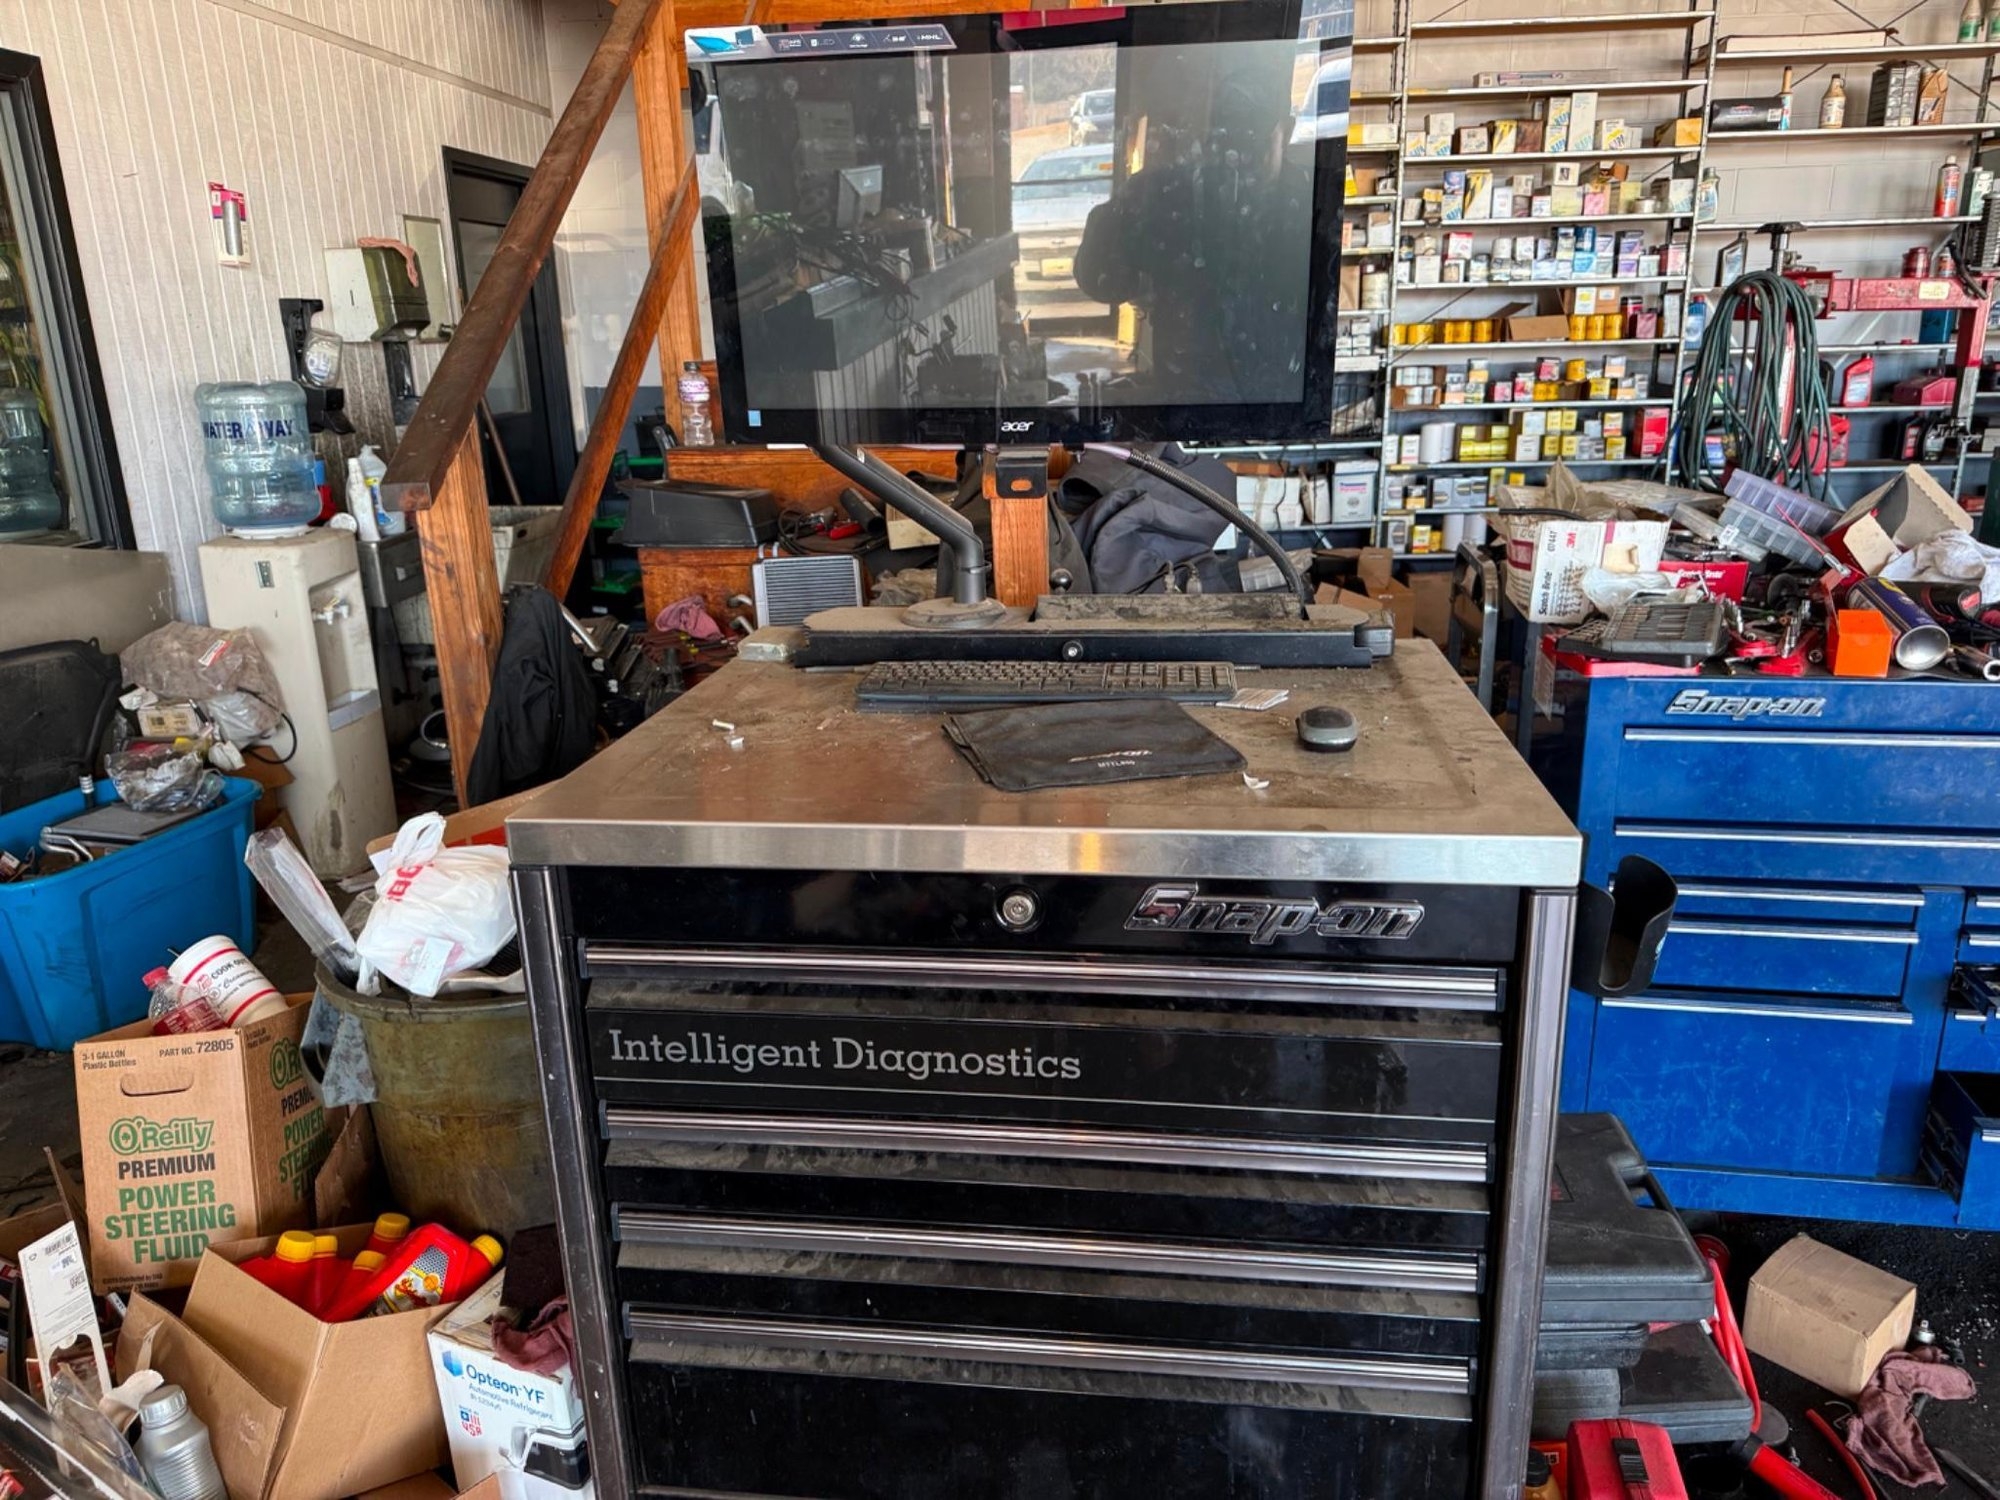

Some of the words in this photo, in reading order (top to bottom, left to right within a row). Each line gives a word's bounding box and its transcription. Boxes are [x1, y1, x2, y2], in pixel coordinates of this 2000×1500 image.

[1001, 421, 1035, 432] acer
[1565, 531, 1577, 549] 3M
[1666, 689, 1827, 721] Snap-on
[1123, 881, 1425, 945] Snap-on
[211, 962, 234, 980] COOK
[96, 1048, 127, 1060] GALLON
[159, 1047, 179, 1058] PART
[181, 1046, 196, 1057] NO.
[196, 1038, 235, 1055] 72805
[607, 1028, 822, 1074] Intelligent
[832, 1037, 1083, 1082] Diagnostics
[82, 1060, 108, 1071] Plastic
[109, 1058, 137, 1069] Bottles
[281, 1087, 315, 1117] PREMI
[110, 1115, 213, 1156] O'Reilly
[284, 1106, 326, 1151] POWER
[118, 1152, 216, 1181] PREMIUM
[118, 1179, 216, 1213] POWER
[104, 1202, 237, 1241] STEERING
[133, 1233, 210, 1264] FLUID
[465, 1363, 519, 1397] Opteon
[523, 1385, 545, 1403] YF
